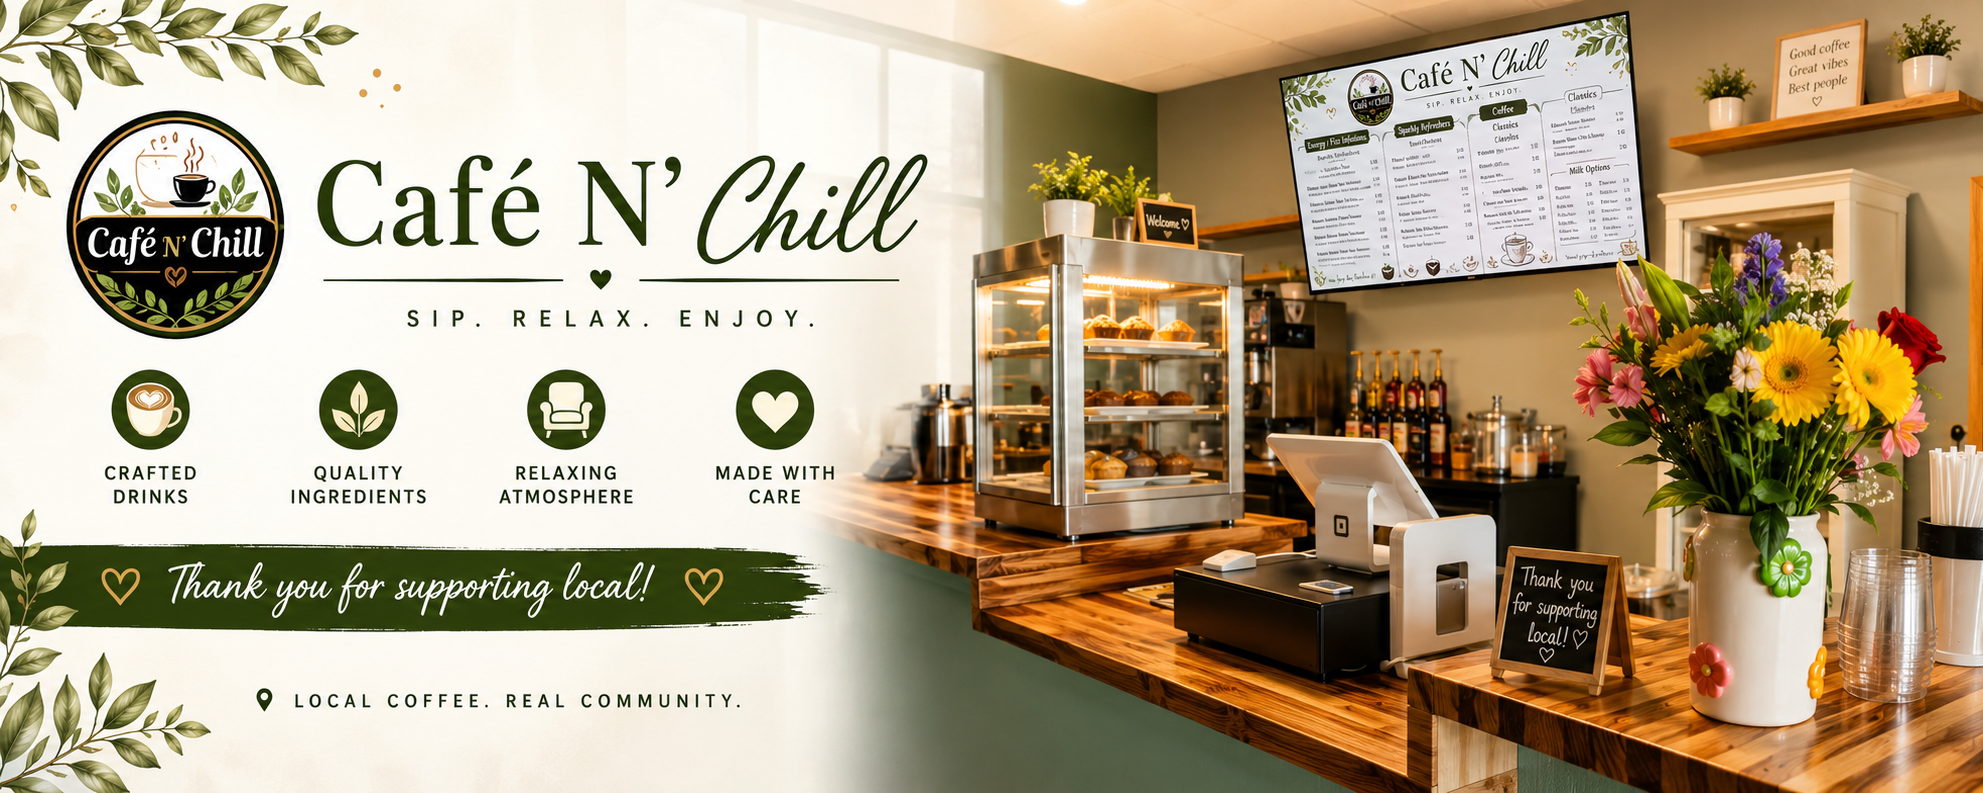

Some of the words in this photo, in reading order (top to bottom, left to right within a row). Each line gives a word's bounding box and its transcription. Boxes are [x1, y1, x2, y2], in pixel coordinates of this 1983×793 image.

[1789, 44, 1816, 60] Good
[1819, 38, 1850, 55] coffee
[1401, 61, 1454, 92] Café
[1492, 39, 1550, 81] Chill
[1789, 62, 1818, 78] Great
[1822, 57, 1848, 71] vibes
[1788, 82, 1810, 95] Best
[1813, 74, 1848, 92] people
[1426, 101, 1445, 109] SIP.
[1450, 94, 1484, 105] RELAX.
[1489, 87, 1522, 98] ENJOY.
[1569, 165, 1584, 175] Milk
[1585, 164, 1611, 175] Options
[1146, 213, 1180, 230] Welcome
[1521, 565, 1563, 589] Thank
[1567, 577, 1594, 600] you
[1512, 592, 1532, 615] for
[1536, 601, 1598, 629] supporting
